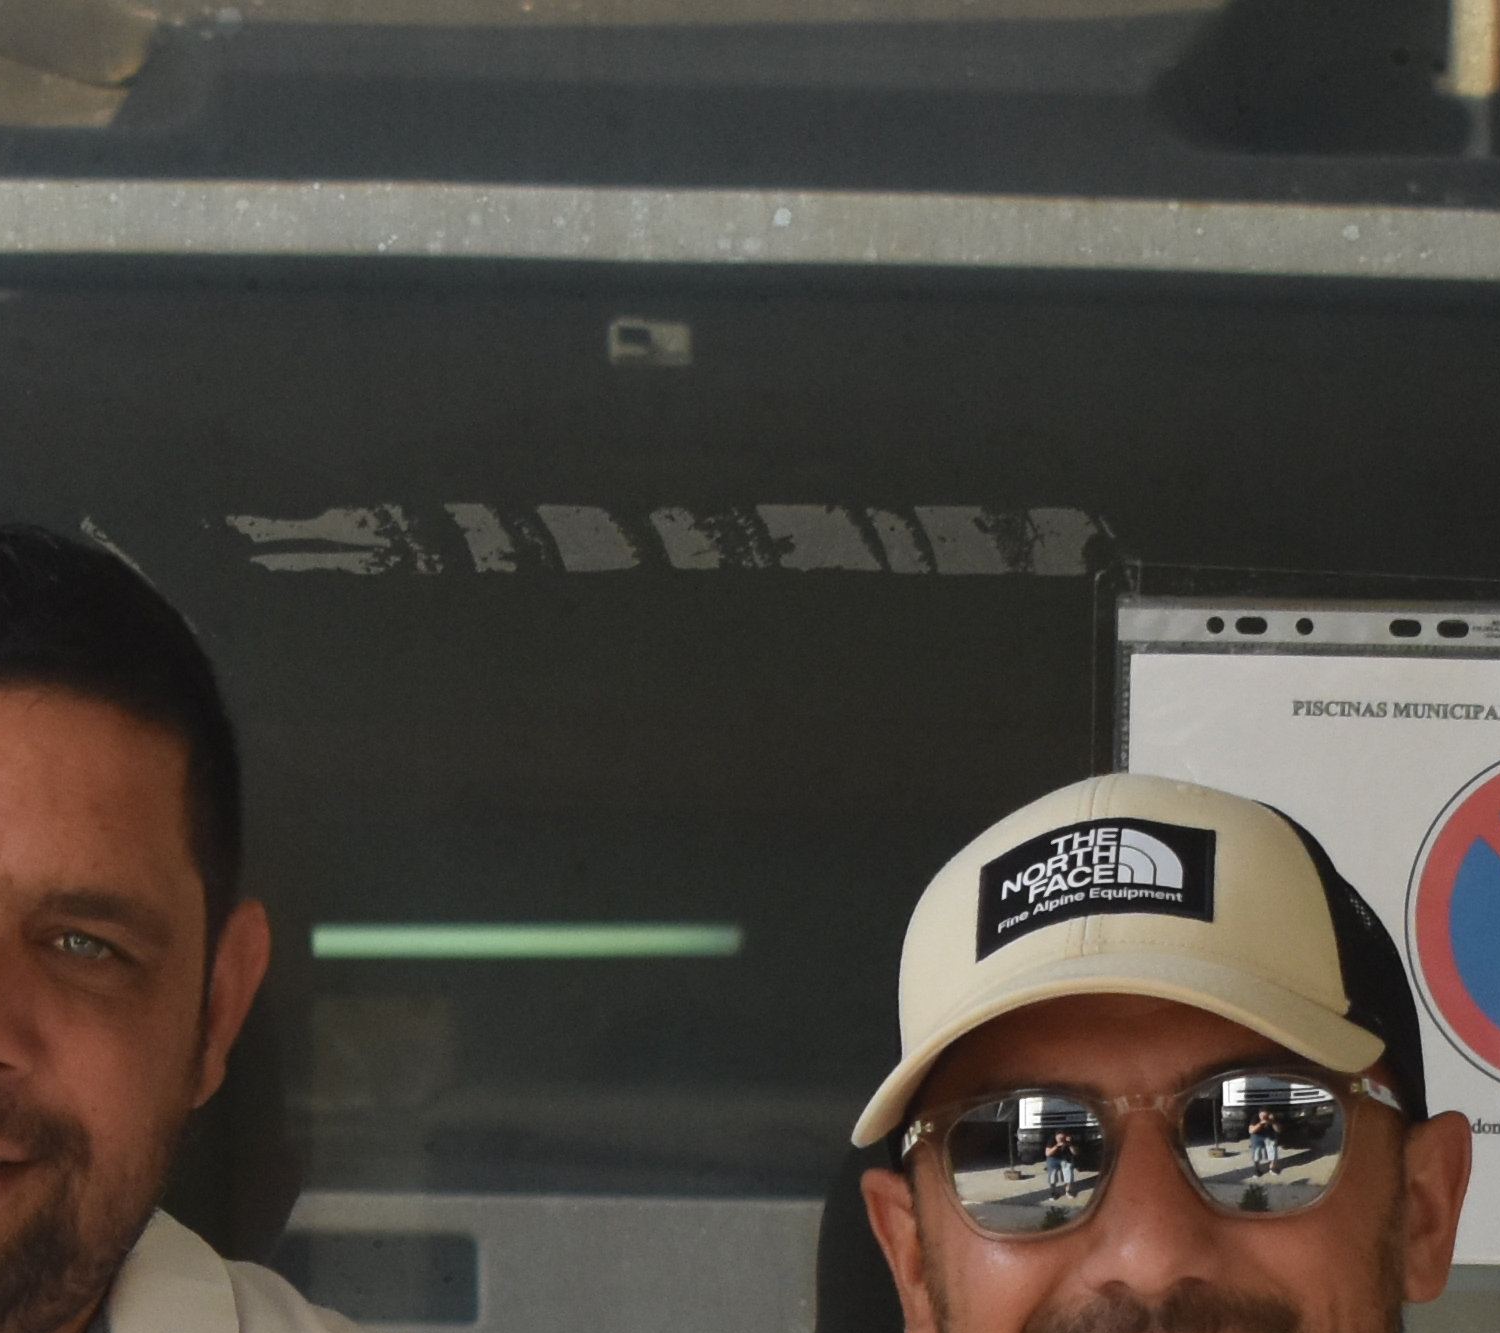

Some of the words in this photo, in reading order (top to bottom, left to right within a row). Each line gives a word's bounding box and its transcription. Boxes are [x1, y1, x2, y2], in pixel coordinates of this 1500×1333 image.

[1292, 701, 1387, 718] PISCINAS
[1051, 827, 1119, 855] THE
[1001, 846, 1116, 900] NORTH
[1028, 864, 1115, 904] FACE
[997, 911, 1029, 934] Fine
[1032, 890, 1085, 916] Alpine
[1089, 886, 1183, 902] Equipment
